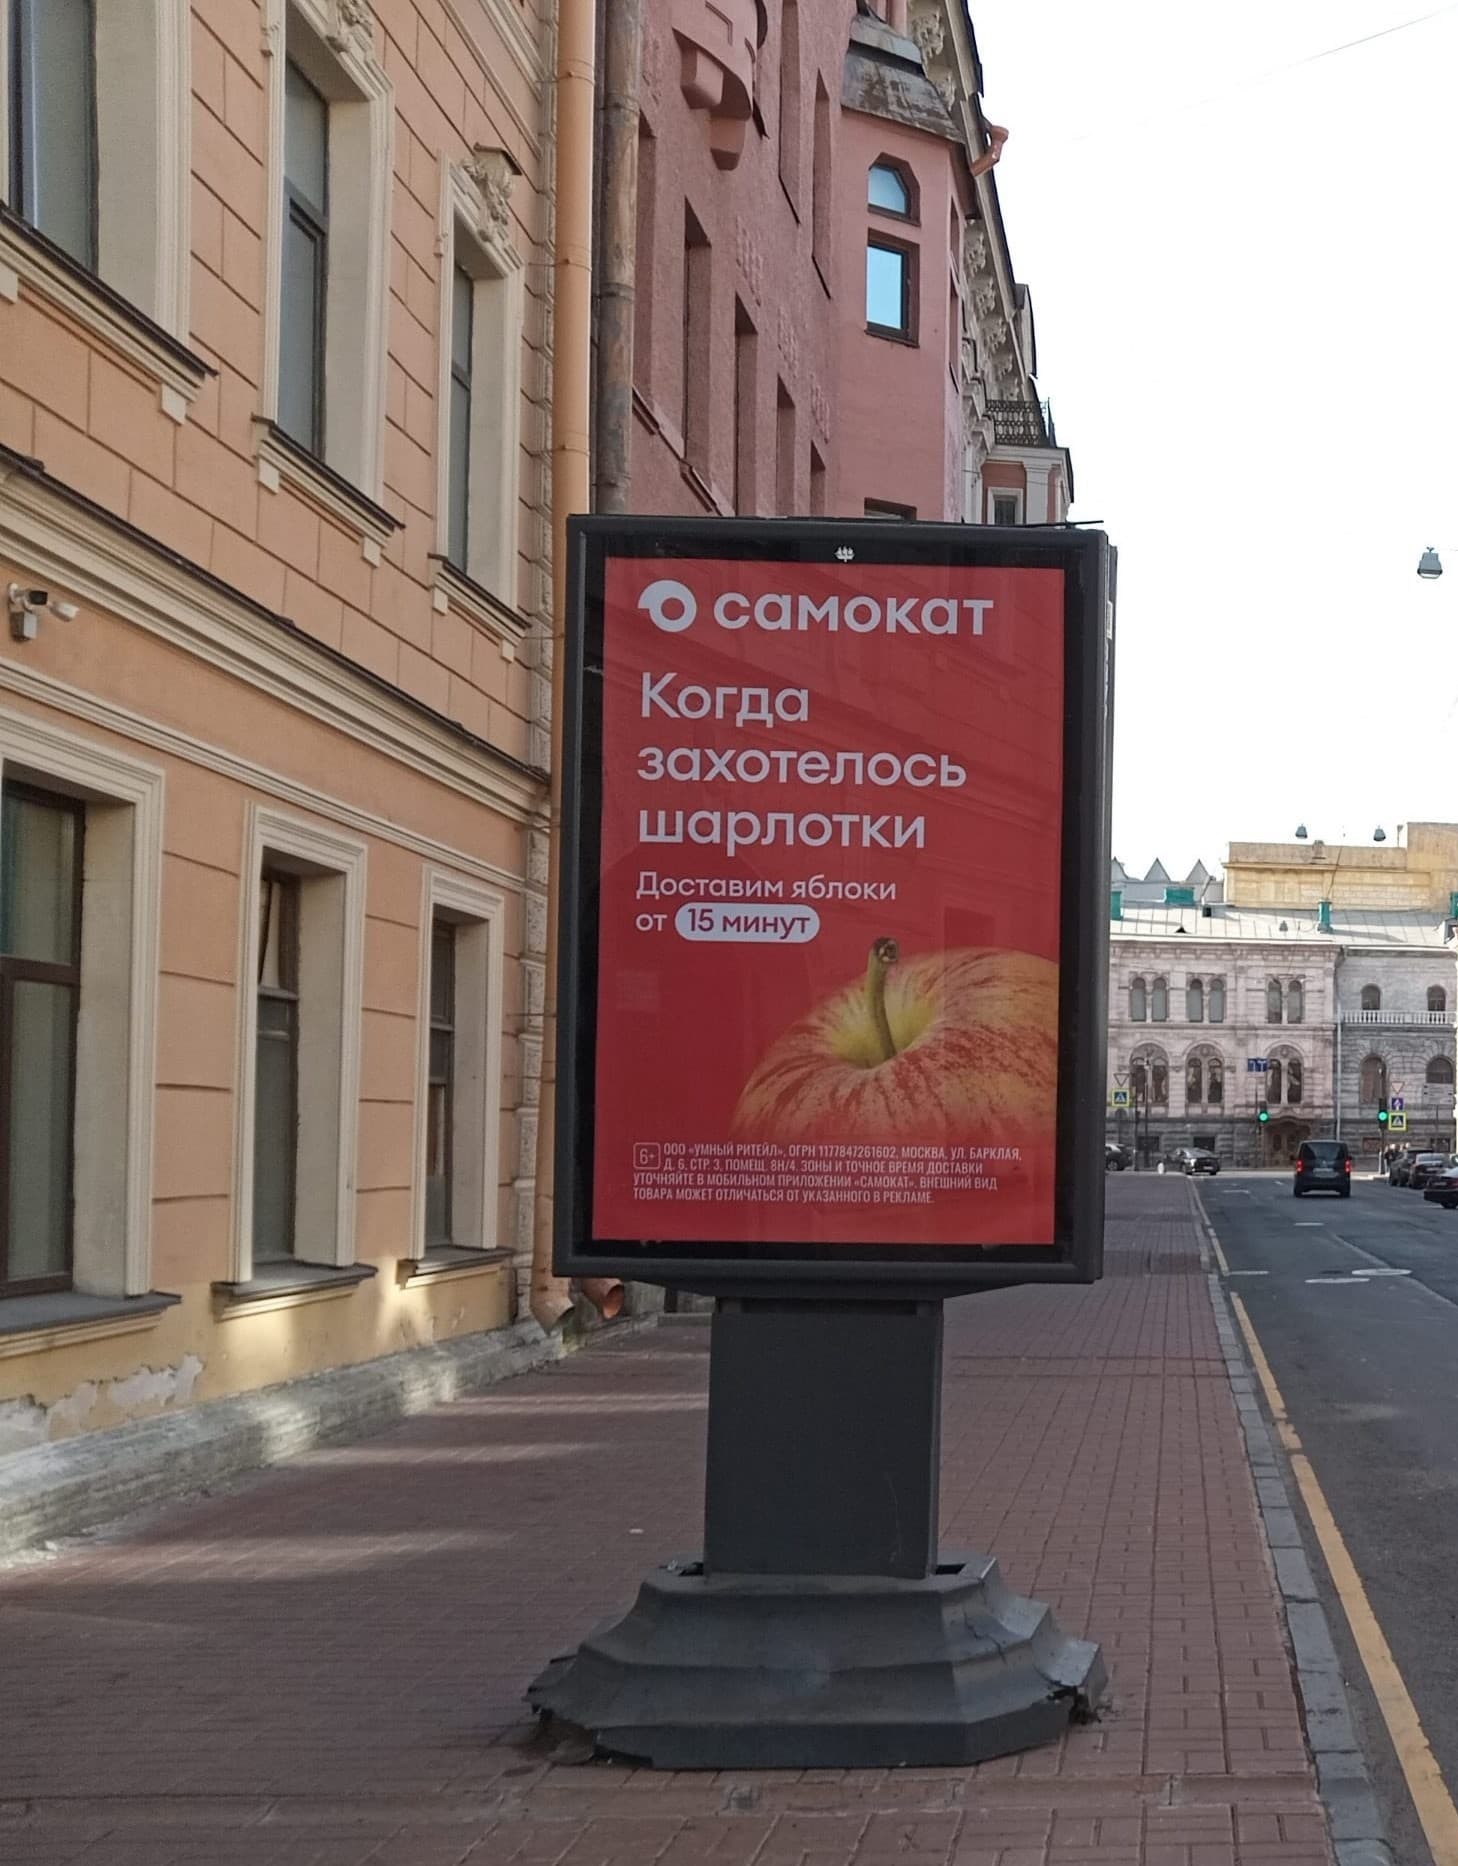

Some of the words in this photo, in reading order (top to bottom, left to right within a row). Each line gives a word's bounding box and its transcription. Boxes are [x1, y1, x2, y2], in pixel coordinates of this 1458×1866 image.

[713, 592, 994, 636] самокат
[640, 671, 809, 728] Когда
[637, 747, 967, 787] захотелось
[639, 809, 925, 857] шарлотки
[636, 871, 783, 899] Доставим
[791, 874, 897, 900] яблоки
[635, 913, 667, 931] от
[687, 908, 714, 932] 15
[722, 915, 810, 940] минут
[639, 1148, 657, 1165] 6+
[663, 1142, 686, 1156] ООО
[788, 1144, 816, 1158] ОГРН
[633, 1170, 695, 1186] УТОЧНЯЙТЕ
[697, 1173, 704, 1185] В
[706, 1173, 775, 1187] МОБИЛЬНОМ
[777, 1174, 852, 1188] ПРИЛОЖЕНИИ
[920, 1175, 972, 1189] ВНЕШНИЙ
[974, 1177, 998, 1191] ВИД
[800, 1160, 832, 1172] ЗОНЫ
[835, 1160, 842, 1173] И
[846, 1160, 886, 1174] ТОЧНОЕ
[889, 1160, 924, 1174] ВРЕМЯ
[926, 1161, 983, 1175] ДОСТАВКИ
[633, 1187, 673, 1200] ТОВАРА
[676, 1188, 713, 1201] МОЖЕТ
[715, 1188, 784, 1201] ОТЛИЧАТЬСЯ
[787, 1189, 800, 1202] ОТ
[802, 1189, 871, 1204] УКАЗАННОГО
[873, 1191, 881, 1203] В
